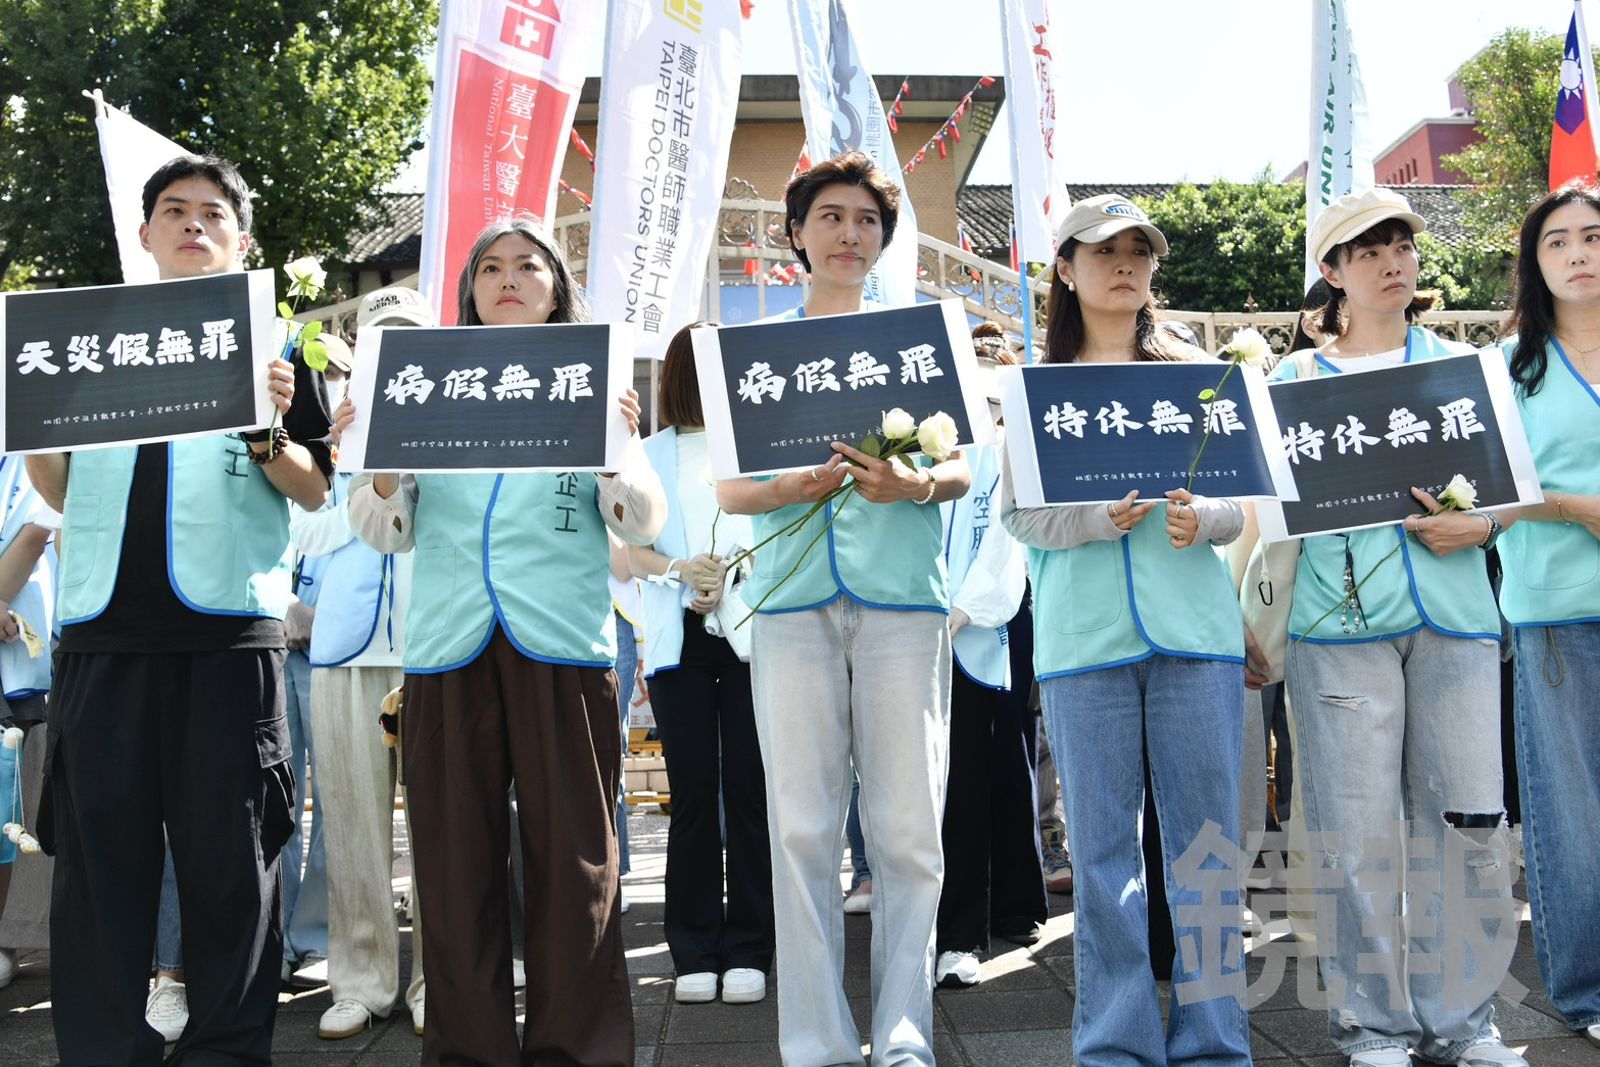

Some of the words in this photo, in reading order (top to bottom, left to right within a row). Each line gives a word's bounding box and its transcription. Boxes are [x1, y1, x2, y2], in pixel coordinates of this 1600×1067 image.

[486, 76, 504, 138] National
[655, 40, 676, 112] TAIPEI
[482, 143, 493, 192] Taiwan
[637, 118, 666, 237] DOCTORS
[642, 43, 698, 334] 臺北市醫師職業工會
[1321, 145, 1333, 206] UNI
[625, 244, 648, 323] UNION
[16, 318, 239, 376] 天災假無罪
[737, 343, 945, 405] 病假無罪
[383, 362, 594, 406] 病假無罪
[1043, 399, 1247, 440] 特休無罪
[1281, 397, 1486, 465] 特休無罪
